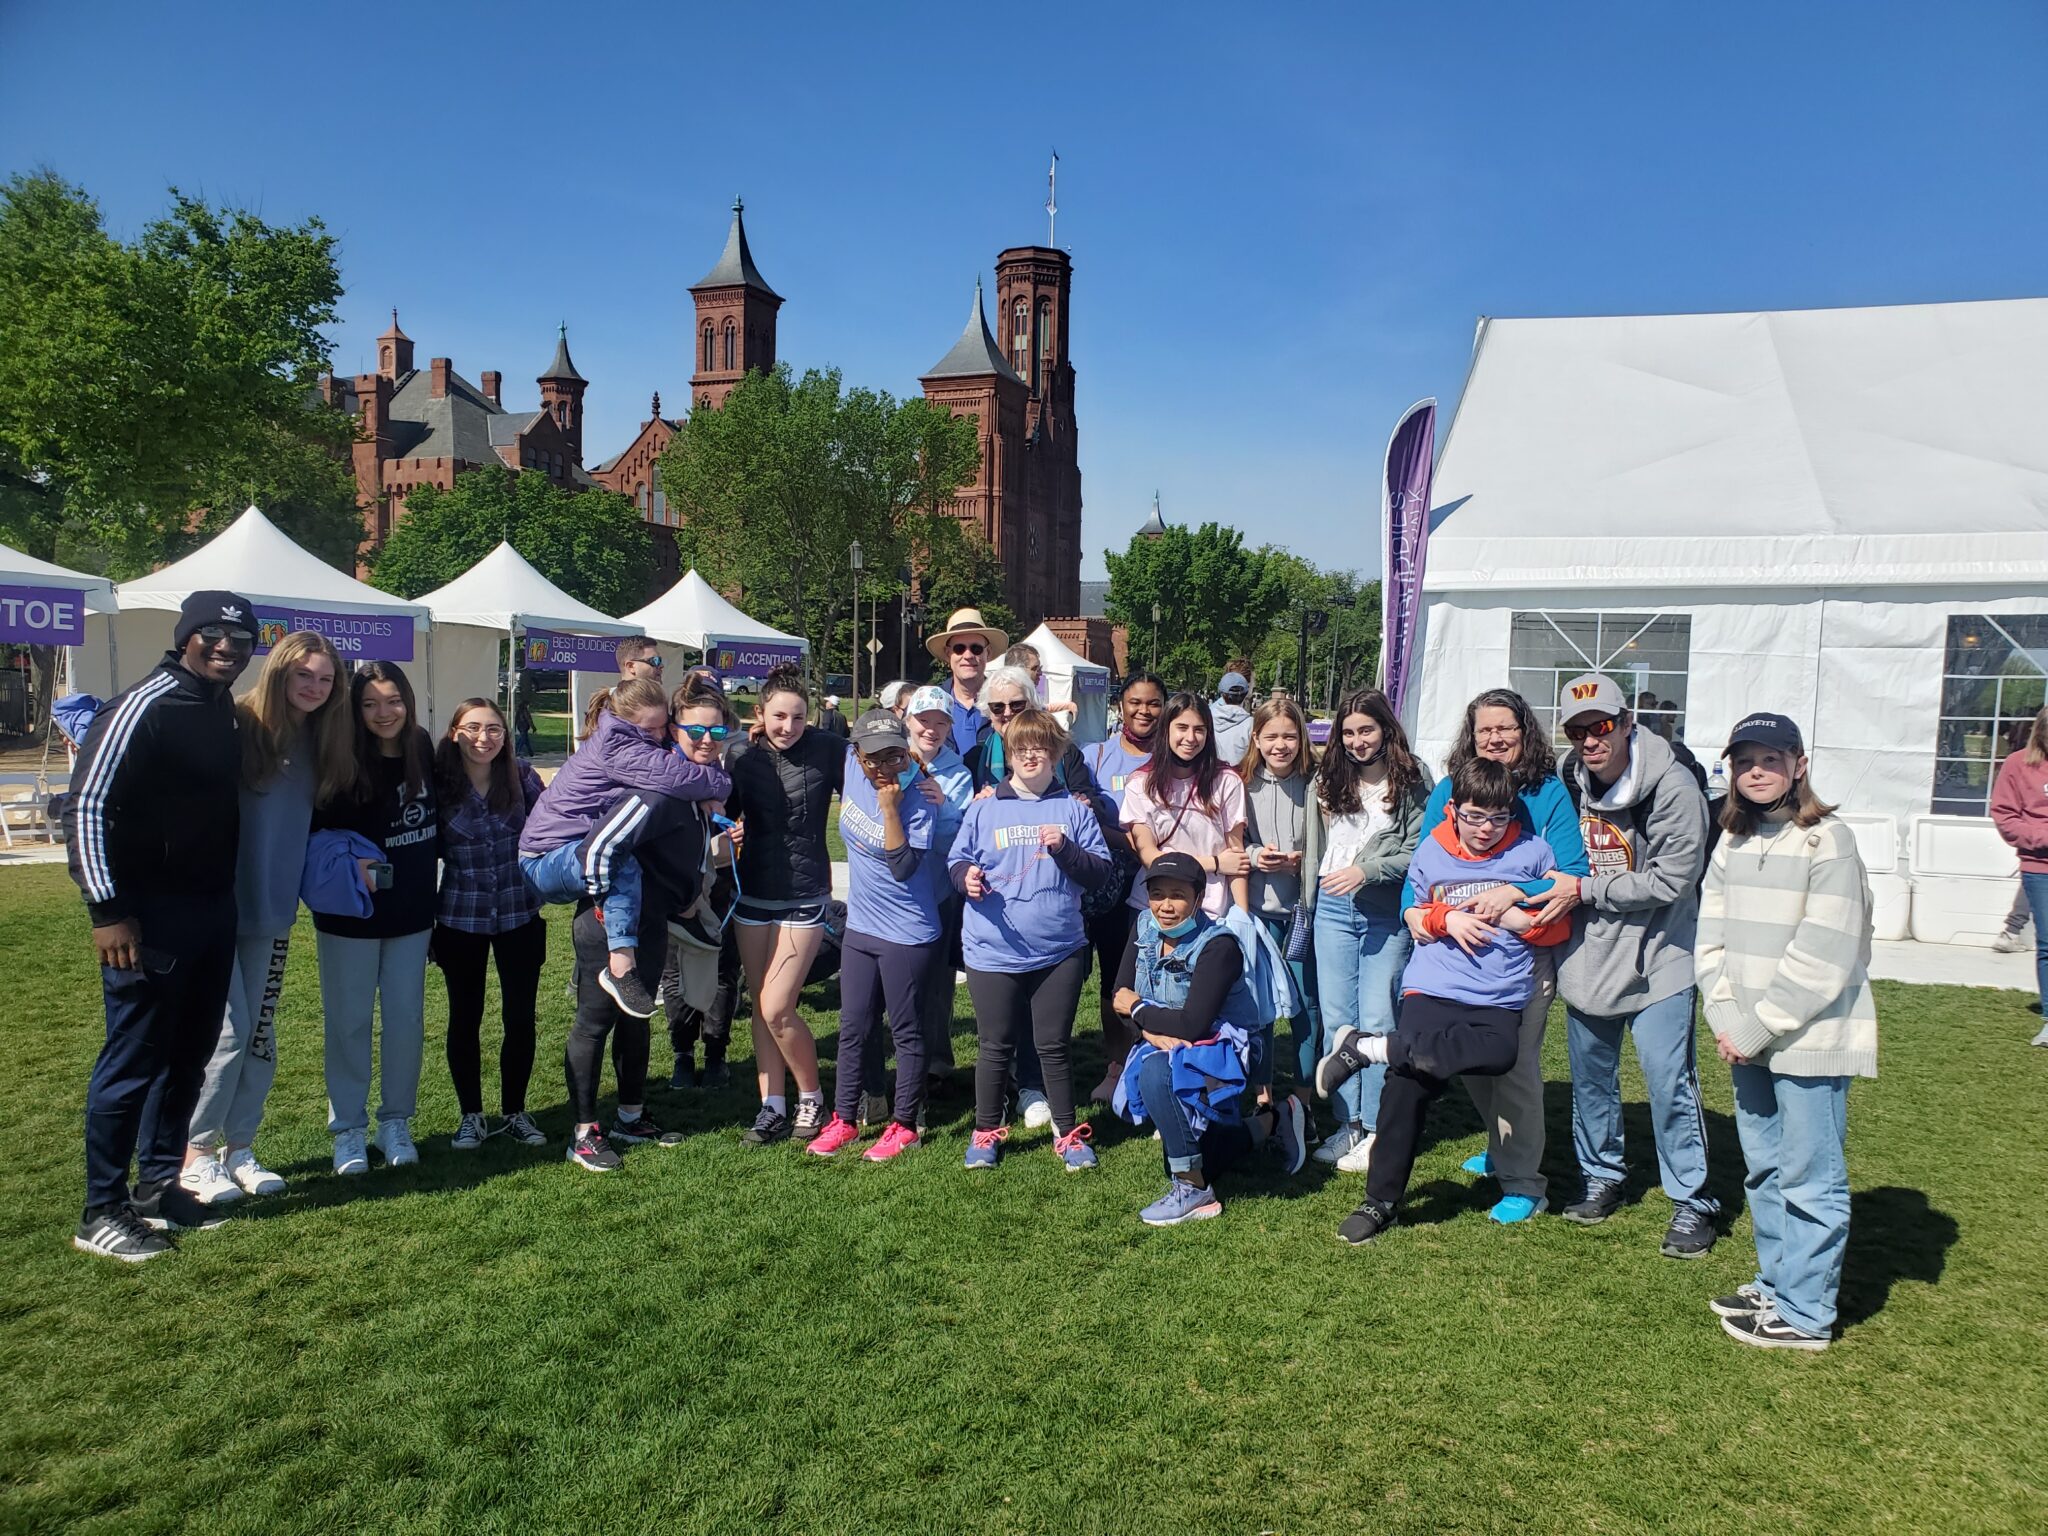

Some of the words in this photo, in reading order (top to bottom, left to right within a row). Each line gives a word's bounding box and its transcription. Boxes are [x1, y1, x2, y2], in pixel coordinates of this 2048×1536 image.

[0, 598, 75, 631] TOE
[294, 616, 330, 632] BEST
[333, 619, 391, 637] BUDDIES
[331, 636, 362, 652] ENS
[552, 636, 576, 650] BEST
[577, 639, 616, 653] BUDDIES
[551, 651, 577, 664] JOBS
[846, 803, 864, 825] BEST
[1009, 826, 1030, 838] BEST
[1010, 837, 1037, 847] FRIENDS
[1447, 883, 1470, 897] BEST
[252, 938, 290, 1064] BERKELEY
[1340, 1051, 1359, 1070] adi
